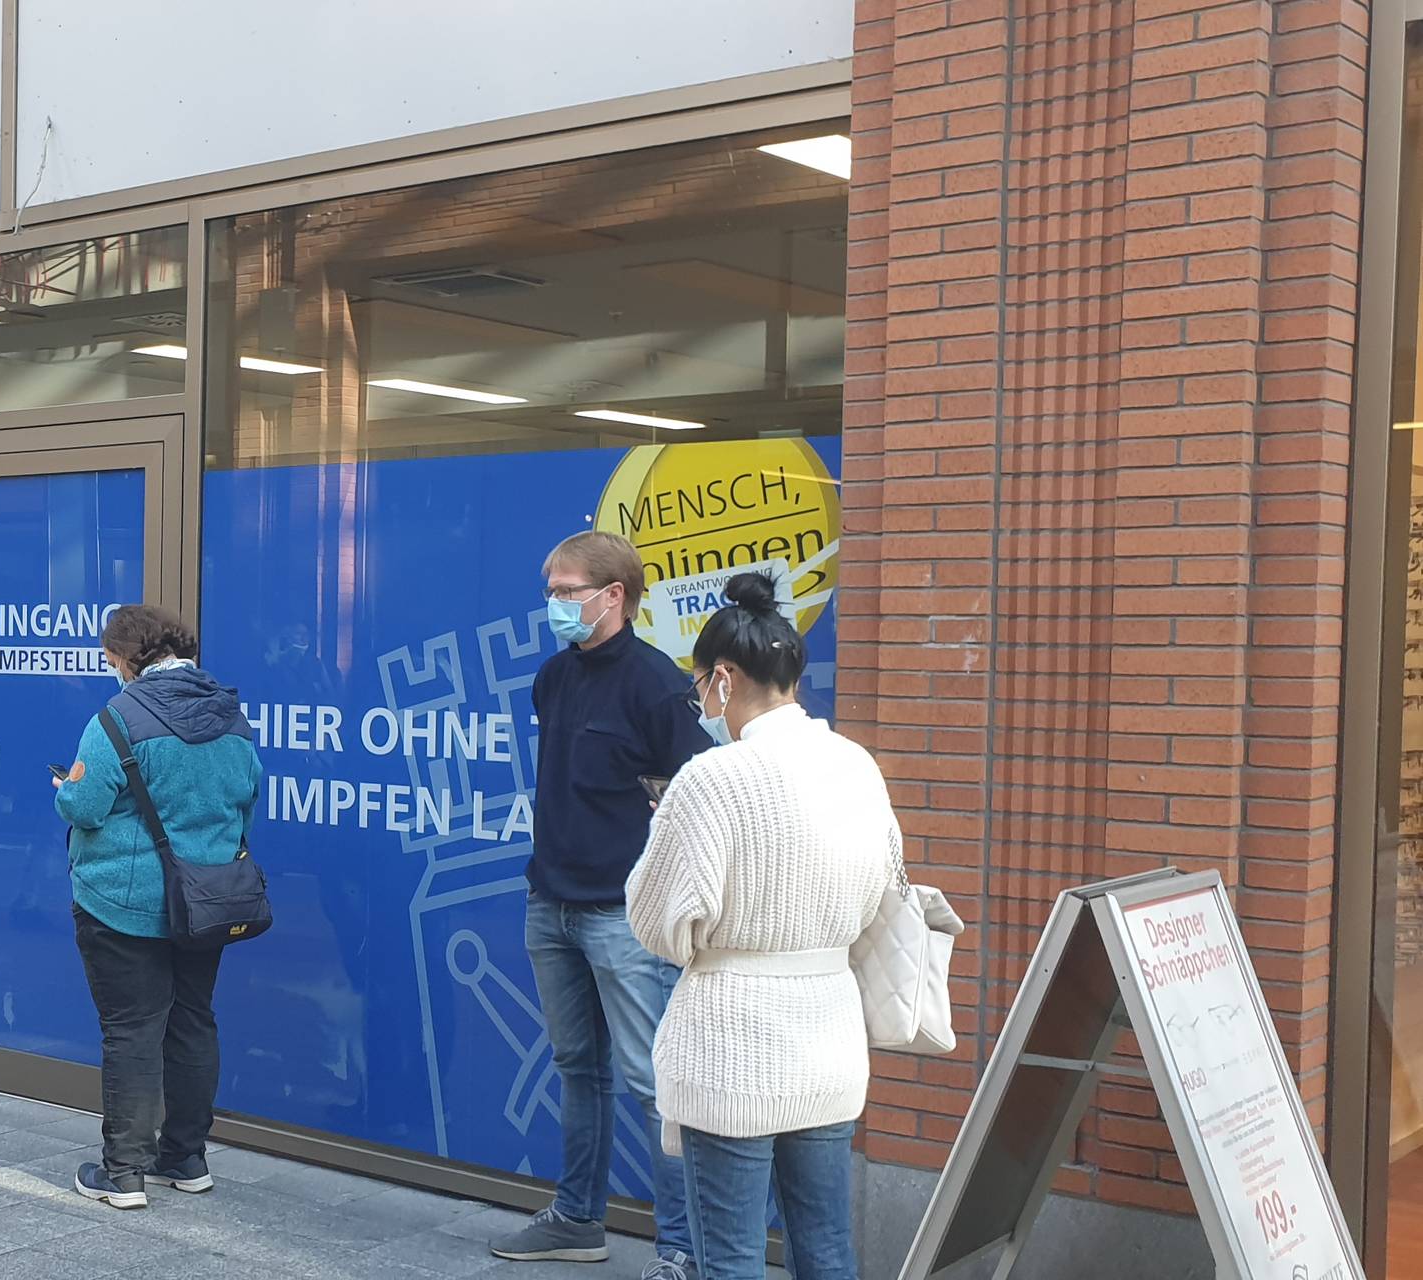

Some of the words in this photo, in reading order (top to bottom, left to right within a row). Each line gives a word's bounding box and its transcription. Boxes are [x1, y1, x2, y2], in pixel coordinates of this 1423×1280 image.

[618, 466, 801, 536] MENSCH,
[642, 529, 826, 600] olingen
[240, 703, 343, 752] HIER
[360, 707, 512, 763] OHNE
[268, 775, 450, 836] IMPFEN
[1143, 911, 1208, 949] Designer
[1139, 941, 1235, 991] Schnäppchen
